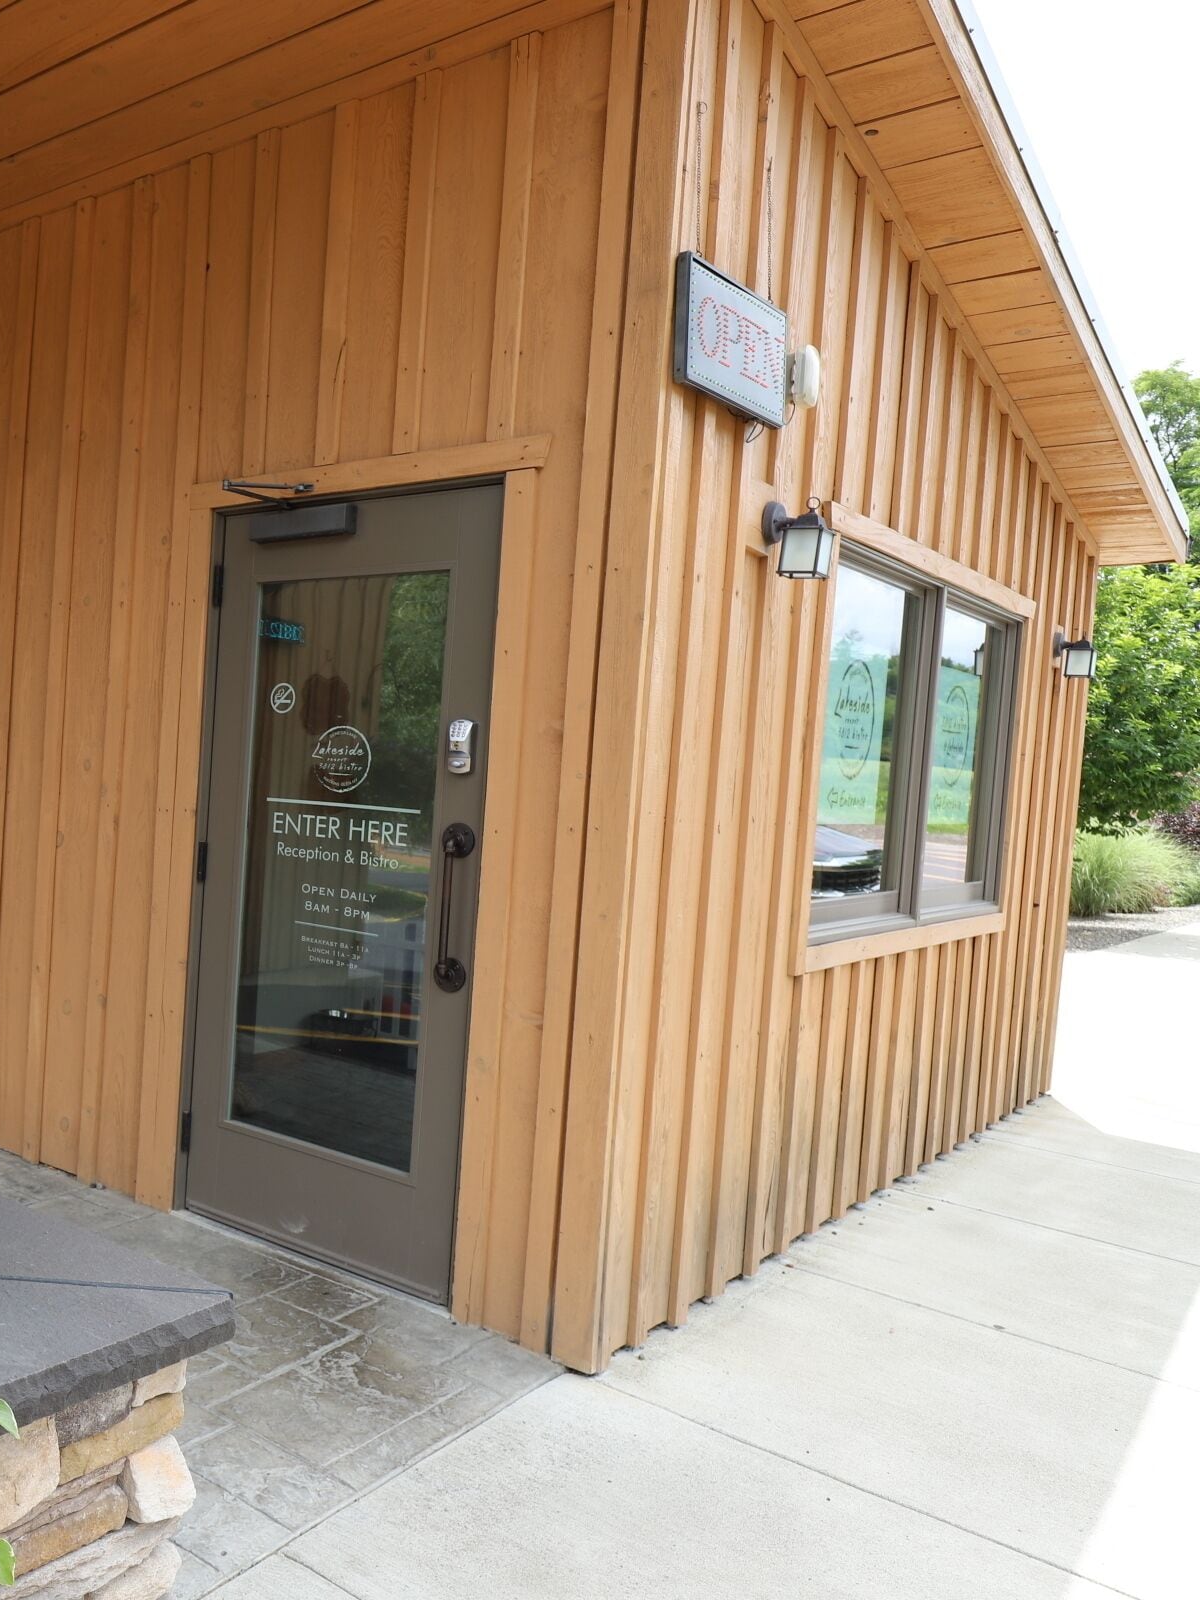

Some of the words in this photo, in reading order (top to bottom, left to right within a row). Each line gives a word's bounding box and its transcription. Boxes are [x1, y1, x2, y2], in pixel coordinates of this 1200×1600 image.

[696, 296, 785, 395] OPEN
[834, 685, 871, 717] Lakeside
[311, 740, 365, 759] Lakeside
[318, 762, 336, 770] 3812
[338, 762, 363, 772] bistro
[272, 812, 341, 840] ENTER
[349, 818, 409, 847] HERE
[277, 841, 340, 863] Reception
[344, 849, 355, 865] &
[360, 851, 399, 870] Bistro
[301, 883, 335, 898] OPEN
[340, 888, 377, 903] DAILY
[304, 901, 330, 914] 8AM
[343, 907, 371, 921] 8PM
[301, 935, 339, 948] BREAKFAST
[307, 944, 330, 955] LUNCH
[309, 955, 334, 965] DINNER
